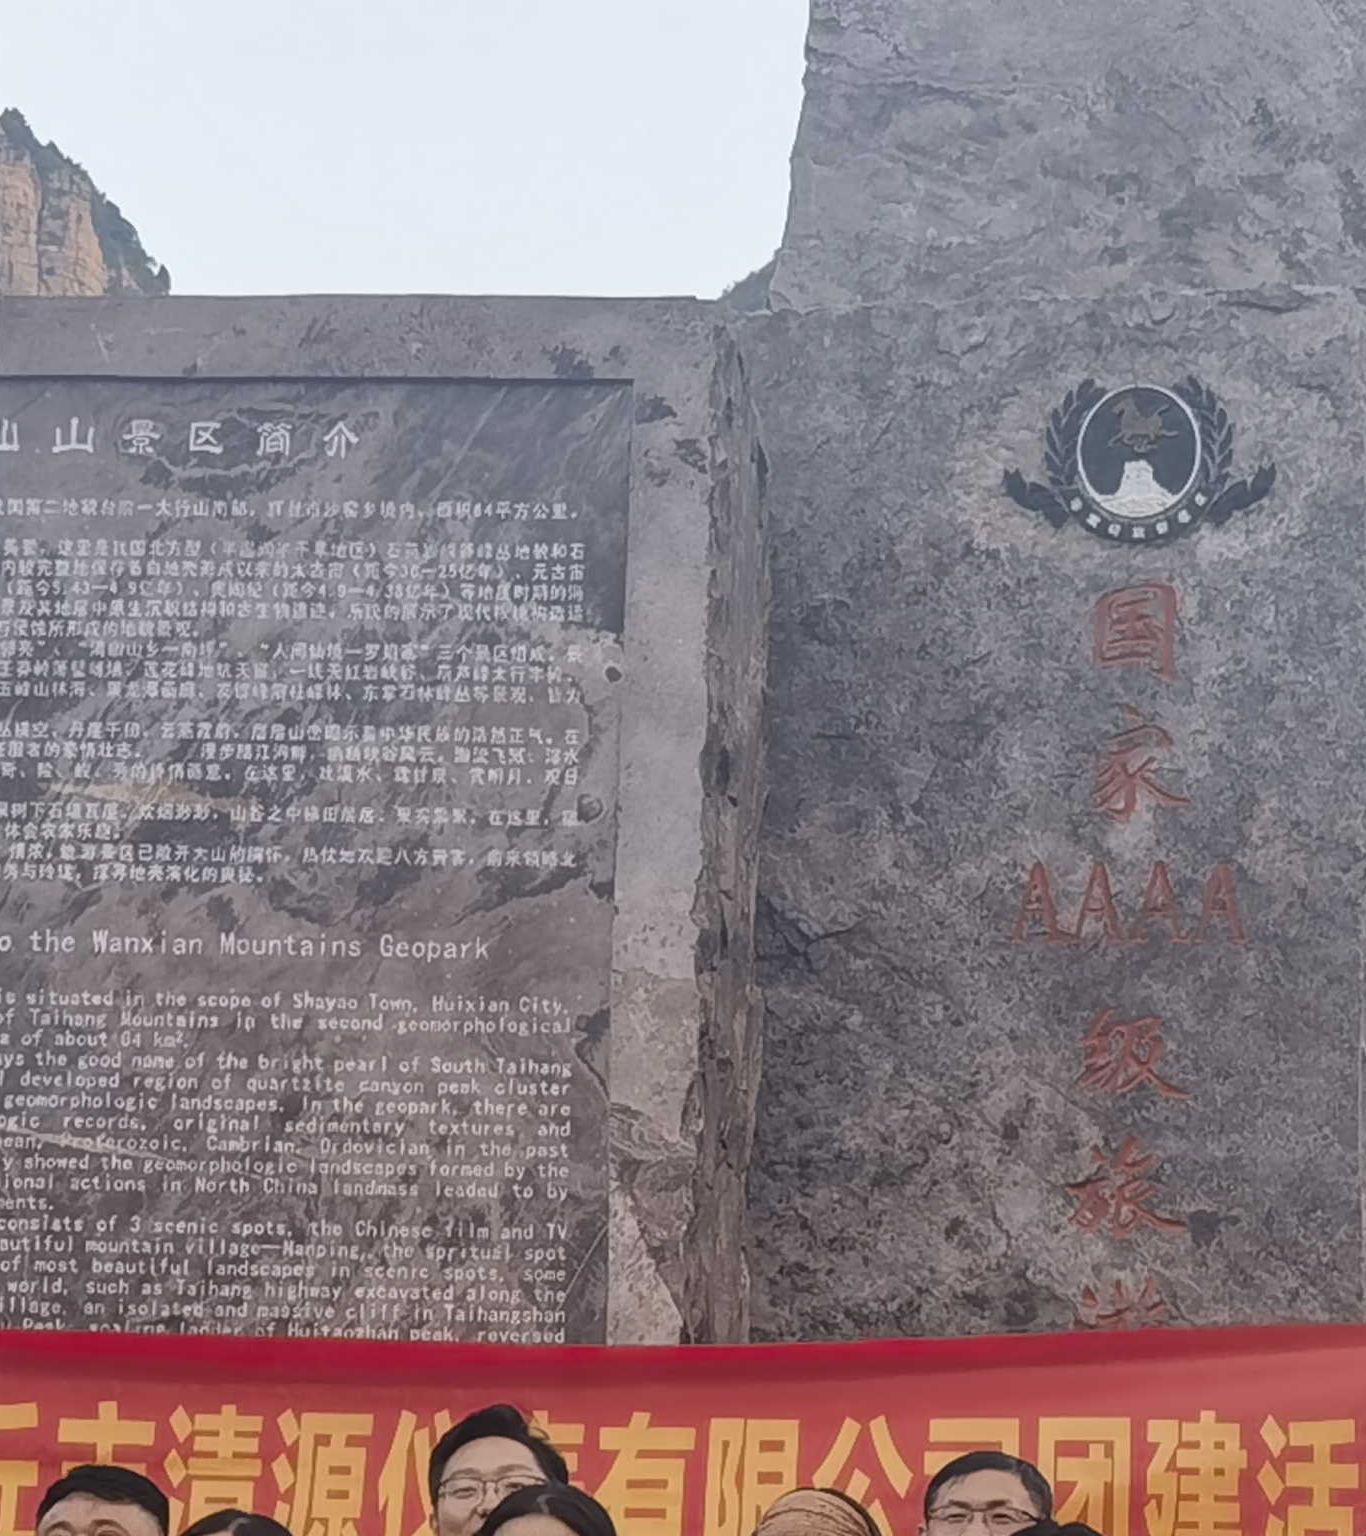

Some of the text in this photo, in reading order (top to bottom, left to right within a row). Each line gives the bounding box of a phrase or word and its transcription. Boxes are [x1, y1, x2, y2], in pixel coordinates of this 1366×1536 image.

[29, 930, 75, 955] the
[93, 930, 203, 956] Wanxian
[220, 932, 361, 958] Mountains
[380, 934, 488, 964] Geopark
[126, 992, 145, 1007] in
[156, 992, 185, 1008] the
[197, 996, 252, 1013] scope
[260, 993, 281, 1009] of
[293, 994, 359, 1014] Shayao
[433, 995, 510, 1011] Huixian
[31, 1011, 108, 1031] Taihang
[120, 1012, 218, 1029] Mountains
[237, 1013, 256, 1029] in
[271, 1014, 303, 1030] the
[318, 1014, 383, 1031] second
[21, 1031, 44, 1047] of
[55, 1032, 108, 1048] about
[37, 1052, 67, 1068] the
[77, 1053, 123, 1073] good
[131, 1057, 175, 1069] name
[184, 1054, 206, 1070] of
[215, 1054, 249, 1070] the
[258, 1055, 324, 1075] bright
[334, 1056, 388, 1076] pearl
[399, 1056, 422, 1072] of
[431, 1057, 487, 1073] South
[497, 1058, 572, 1078] Taihang
[20, 1073, 120, 1093] developed
[133, 1074, 199, 1094] region
[211, 1075, 235, 1091] of
[360, 1080, 425, 1097] canyon
[438, 1077, 480, 1097] peak
[494, 1078, 572, 1094] cluster
[303, 1096, 322, 1112] In
[334, 1097, 364, 1113] the
[475, 1098, 528, 1114] there
[538, 1103, 571, 1115] are
[70, 1176, 146, 1192] actions
[162, 1177, 182, 1193] in
[195, 1177, 250, 1193] North
[262, 1178, 317, 1194] China
[334, 1179, 419, 1195] landmass
[512, 1182, 534, 1197] to
[547, 1181, 567, 1201] by
[96, 1217, 118, 1233] of
[130, 1218, 140, 1233] 3
[154, 1218, 220, 1234] scenic
[311, 1220, 342, 1236] the
[355, 1220, 434, 1237] Chinese
[446, 1221, 490, 1237] film
[501, 1222, 534, 1238] and
[549, 1222, 567, 1238] TV
[87, 1279, 129, 1295] such
[143, 1283, 163, 1295] as
[178, 1280, 252, 1300] Taihang
[265, 1281, 341, 1301] highway
[354, 1282, 455, 1298] excavated
[465, 1283, 521, 1303] along
[535, 1284, 567, 1300] the
